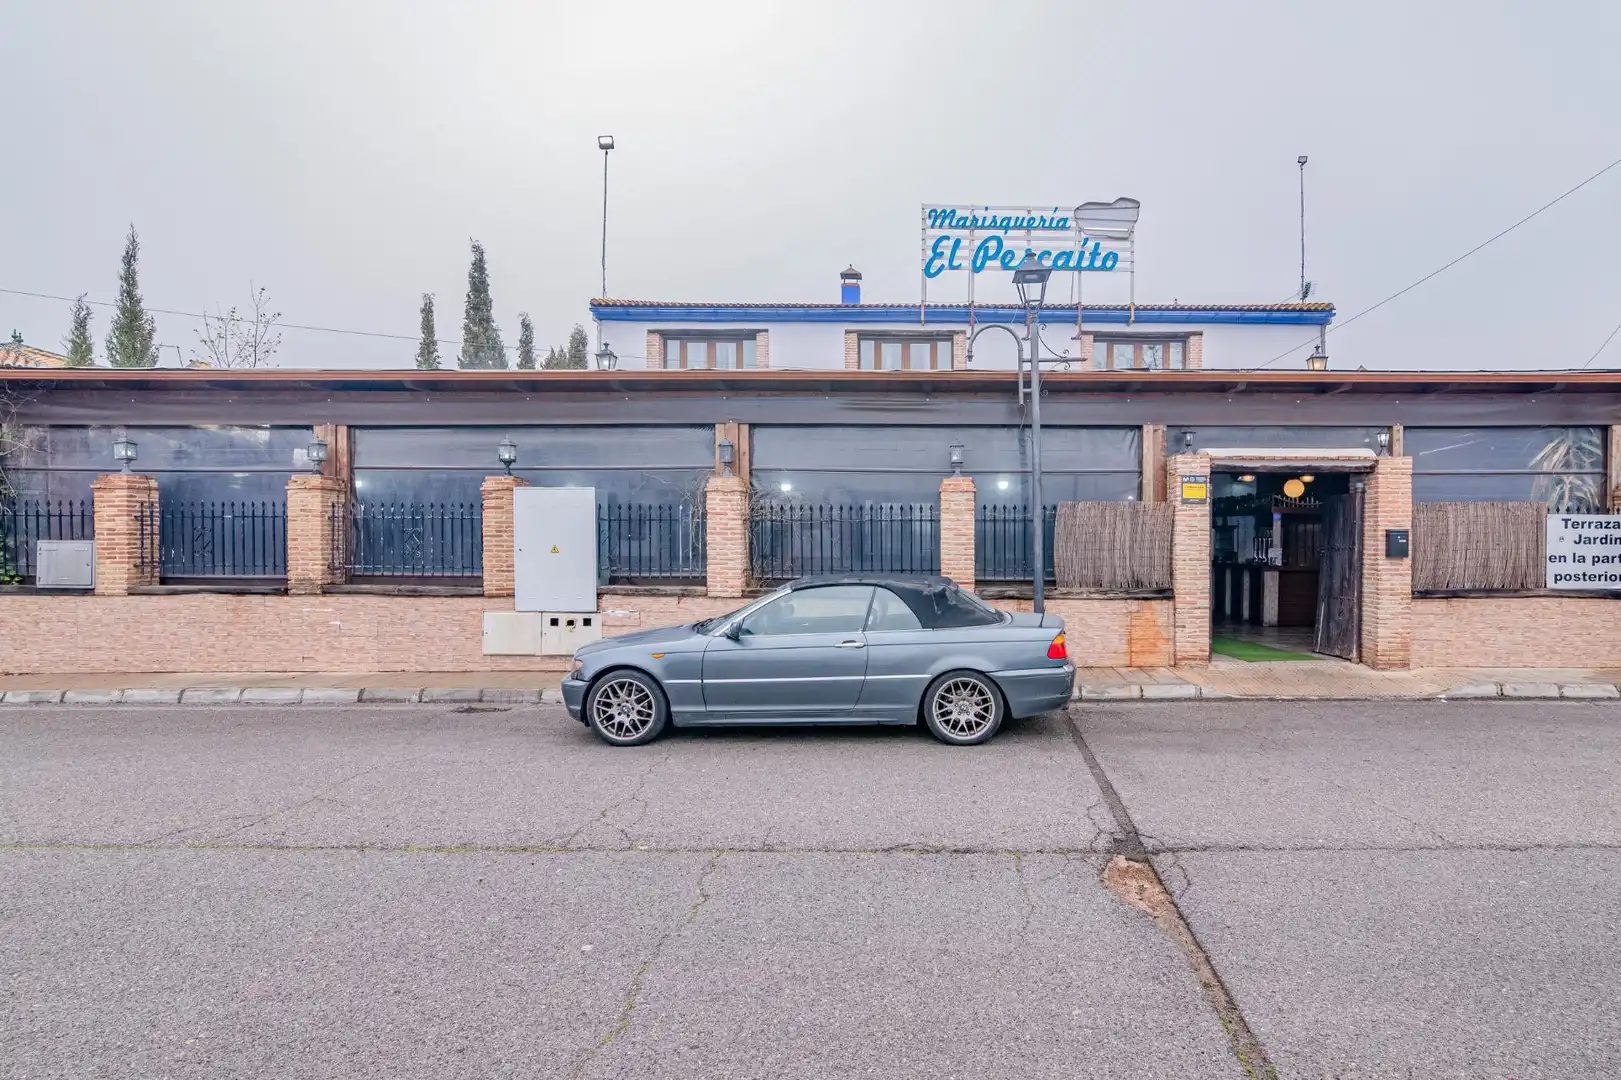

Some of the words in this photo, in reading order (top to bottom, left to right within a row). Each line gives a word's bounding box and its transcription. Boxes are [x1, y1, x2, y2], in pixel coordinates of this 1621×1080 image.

[928, 206, 1071, 234] Marisquería
[924, 235, 962, 278] El
[1561, 518, 1621, 530] Terraza
[1548, 554, 1567, 563] en
[1572, 552, 1586, 563] la
